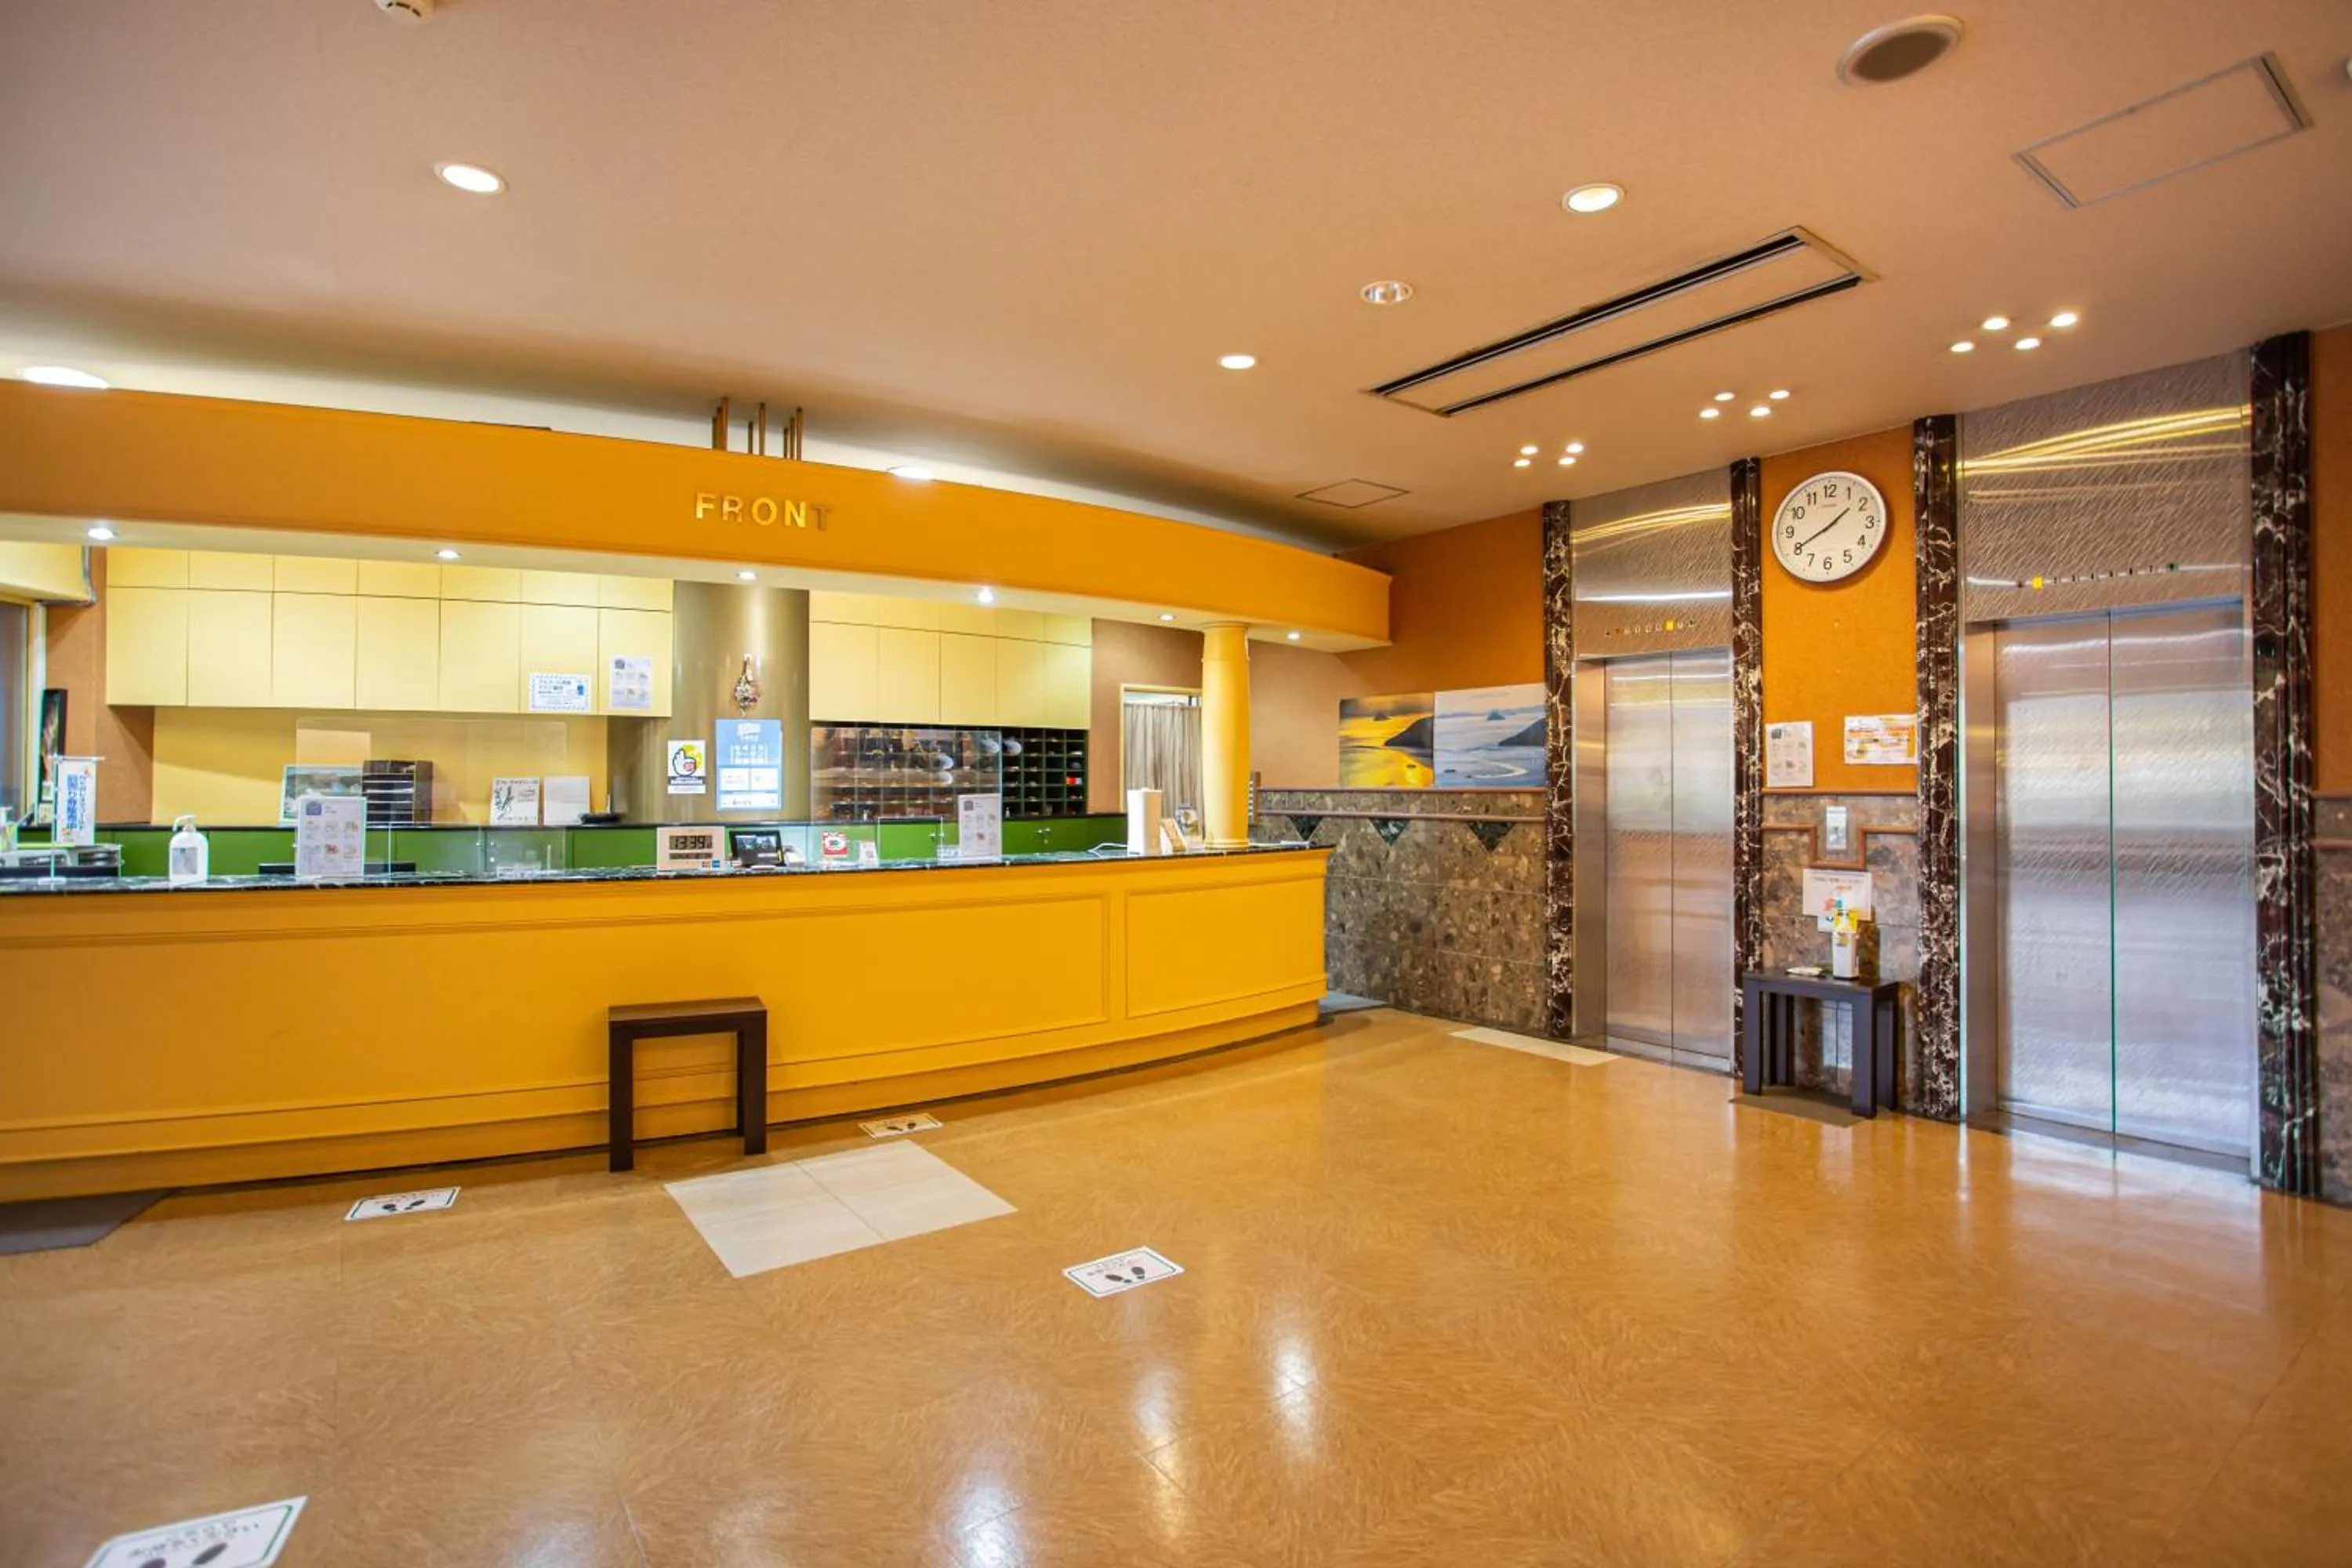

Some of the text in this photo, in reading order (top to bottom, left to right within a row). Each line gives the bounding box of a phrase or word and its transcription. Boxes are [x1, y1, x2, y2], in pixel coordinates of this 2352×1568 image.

[1824, 484, 1837, 498] 12
[1846, 486, 1851, 500] 1
[1806, 492, 1817, 506] 11
[1858, 496, 1867, 512] 2
[695, 492, 834, 532] FRONT
[1791, 506, 1805, 520] 10
[1865, 515, 1875, 529] 3
[1785, 524, 1795, 539] 9
[1857, 534, 1866, 548] 4
[1794, 542, 1802, 556] 8
[1843, 549, 1853, 563] 5
[1806, 553, 1815, 566] 7
[1823, 556, 1832, 570] 6
